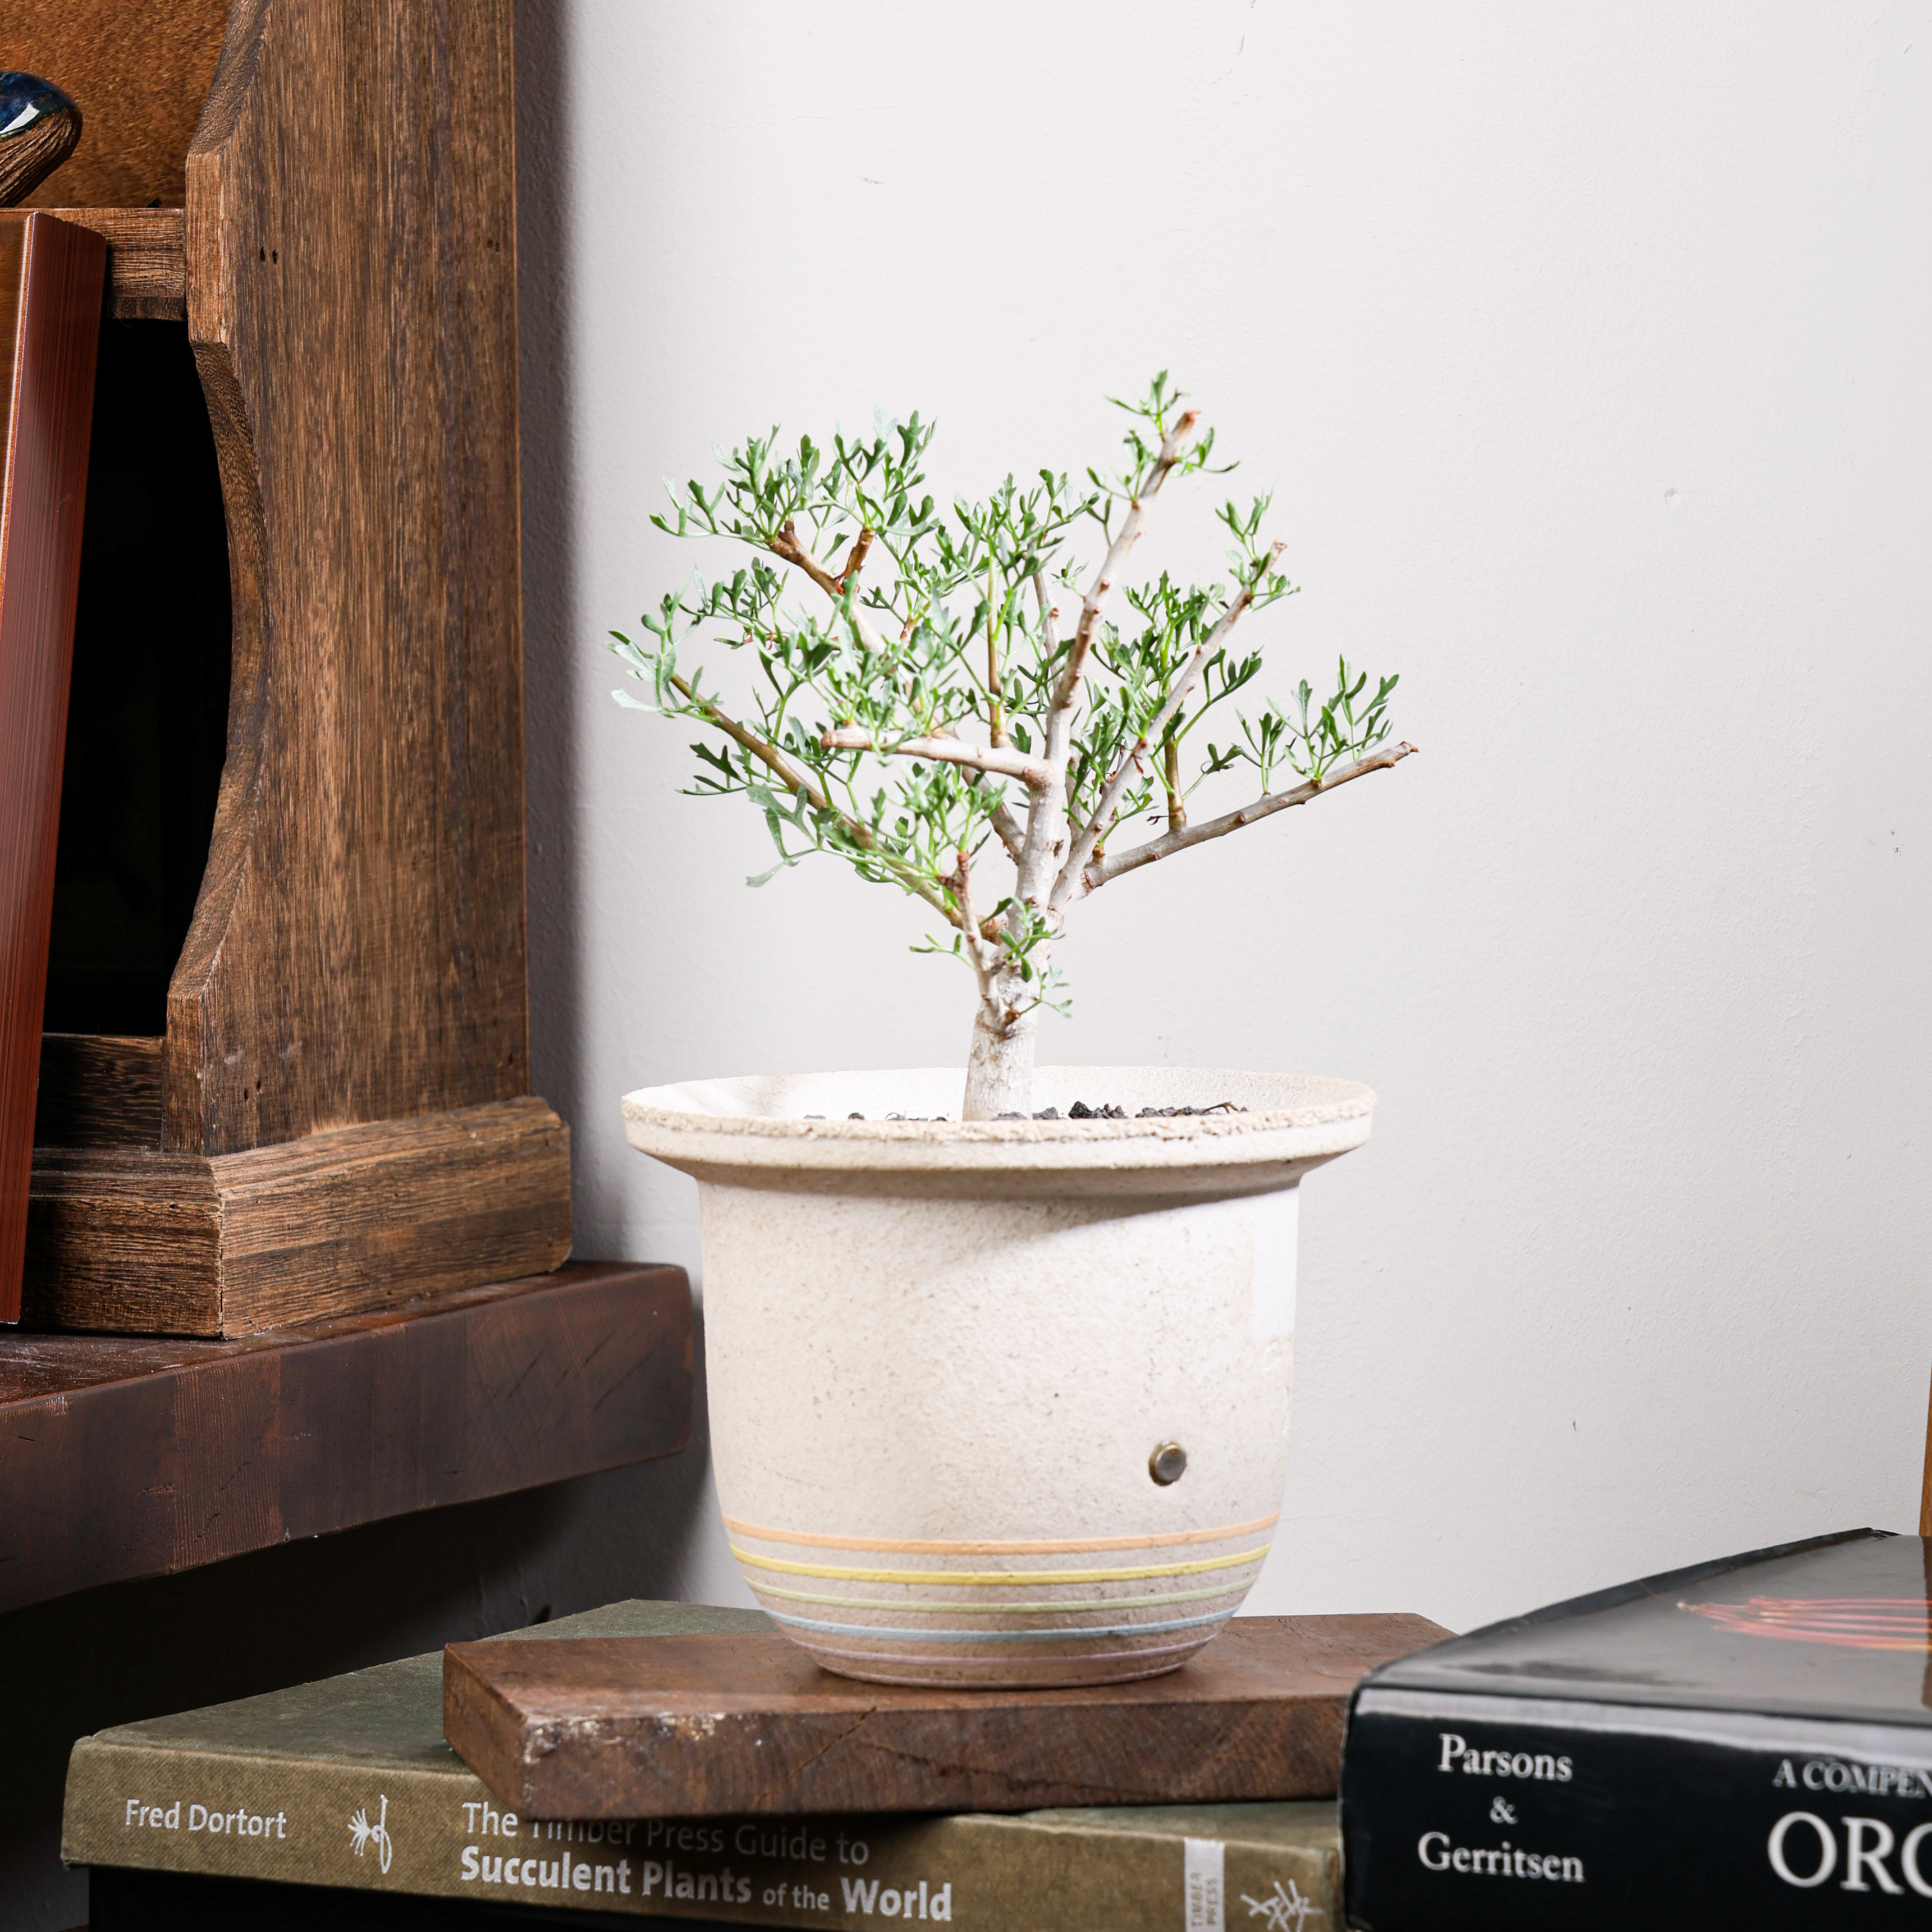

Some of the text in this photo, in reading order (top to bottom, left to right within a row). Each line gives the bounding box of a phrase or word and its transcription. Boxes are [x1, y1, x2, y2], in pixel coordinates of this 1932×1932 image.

[1437, 1733, 1573, 1783] Parsons
[1773, 1759, 1797, 1788] A
[125, 1799, 287, 1839] Fred Dortort
[462, 1801, 518, 1837] The
[647, 1819, 723, 1852] Press
[734, 1825, 826, 1862] Guide
[837, 1834, 869, 1865] to
[1490, 1796, 1518, 1825] &
[1417, 1831, 1586, 1883] Gerritsen
[460, 1846, 953, 1922] Succulent Plants of the World
